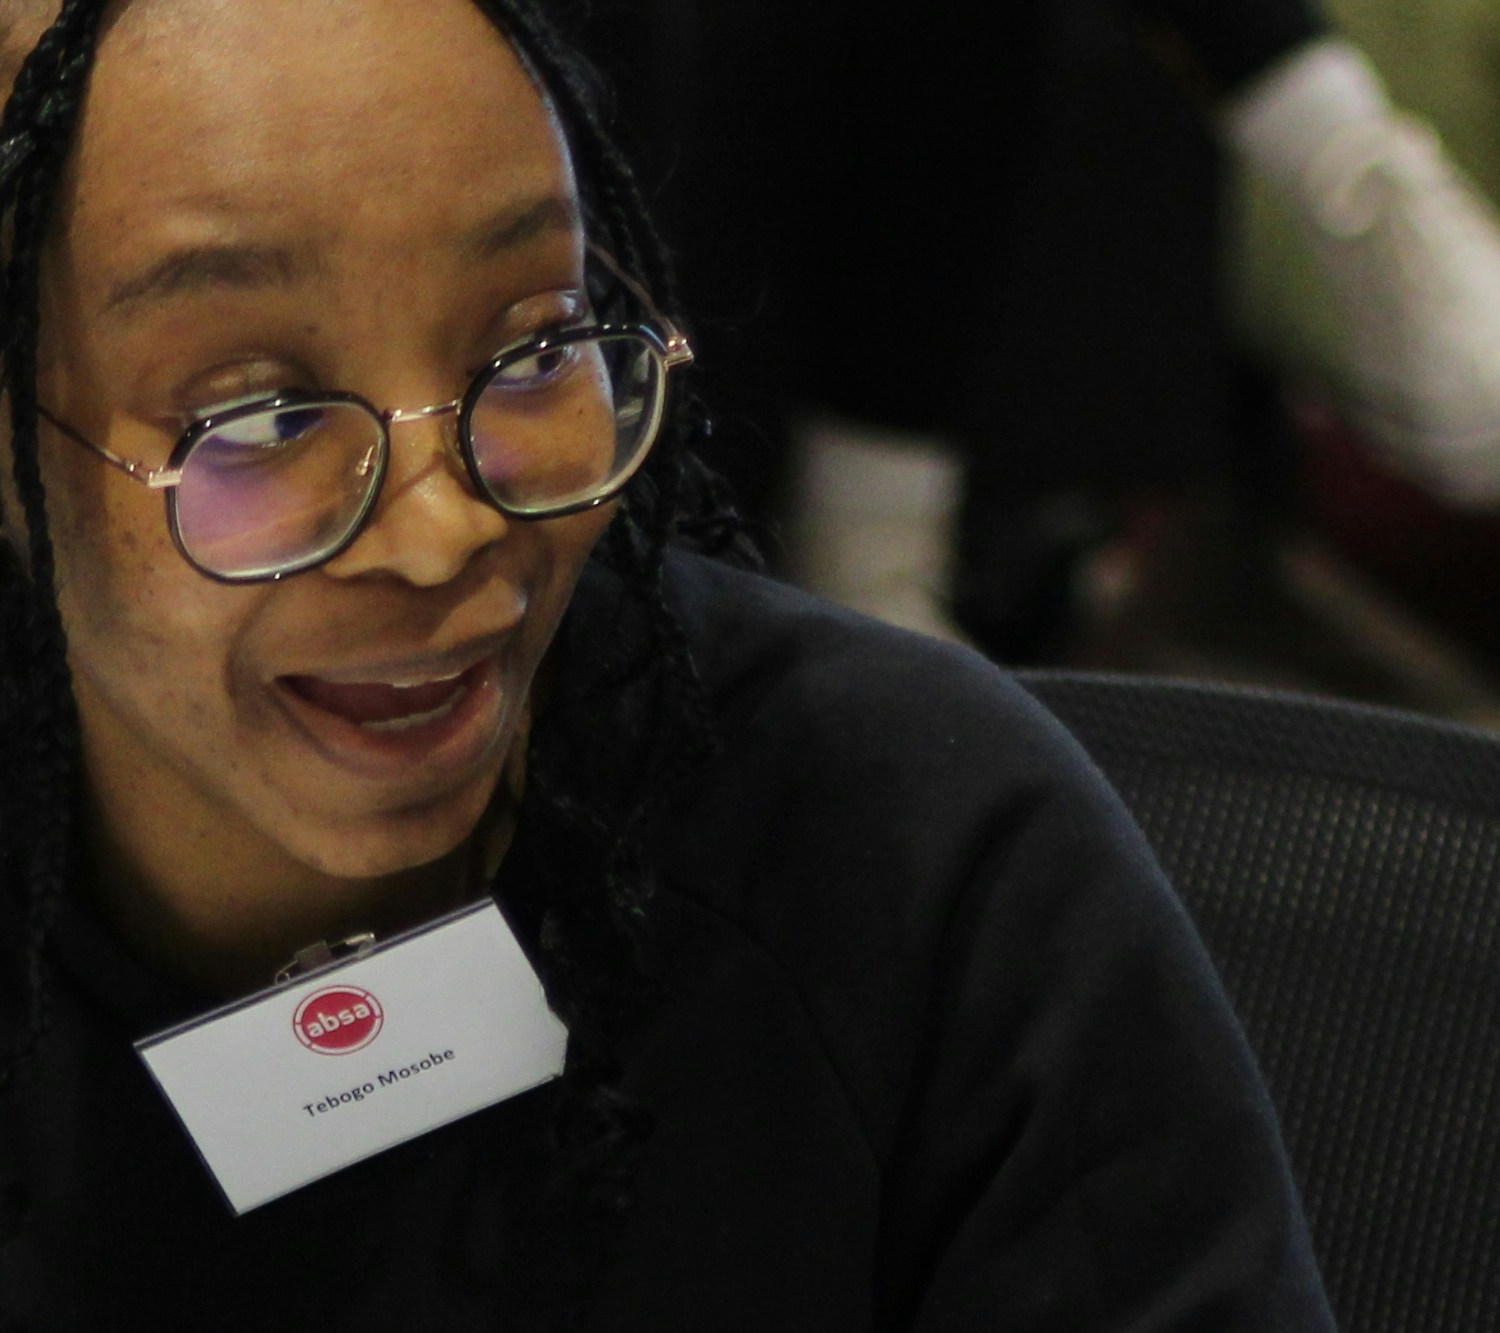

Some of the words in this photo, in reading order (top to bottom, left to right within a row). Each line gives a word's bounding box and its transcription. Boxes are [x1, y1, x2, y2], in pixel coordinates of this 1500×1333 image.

[306, 1001, 371, 1039] absa
[303, 1081, 375, 1118] Tebogo
[377, 1046, 456, 1087] Mosobe
